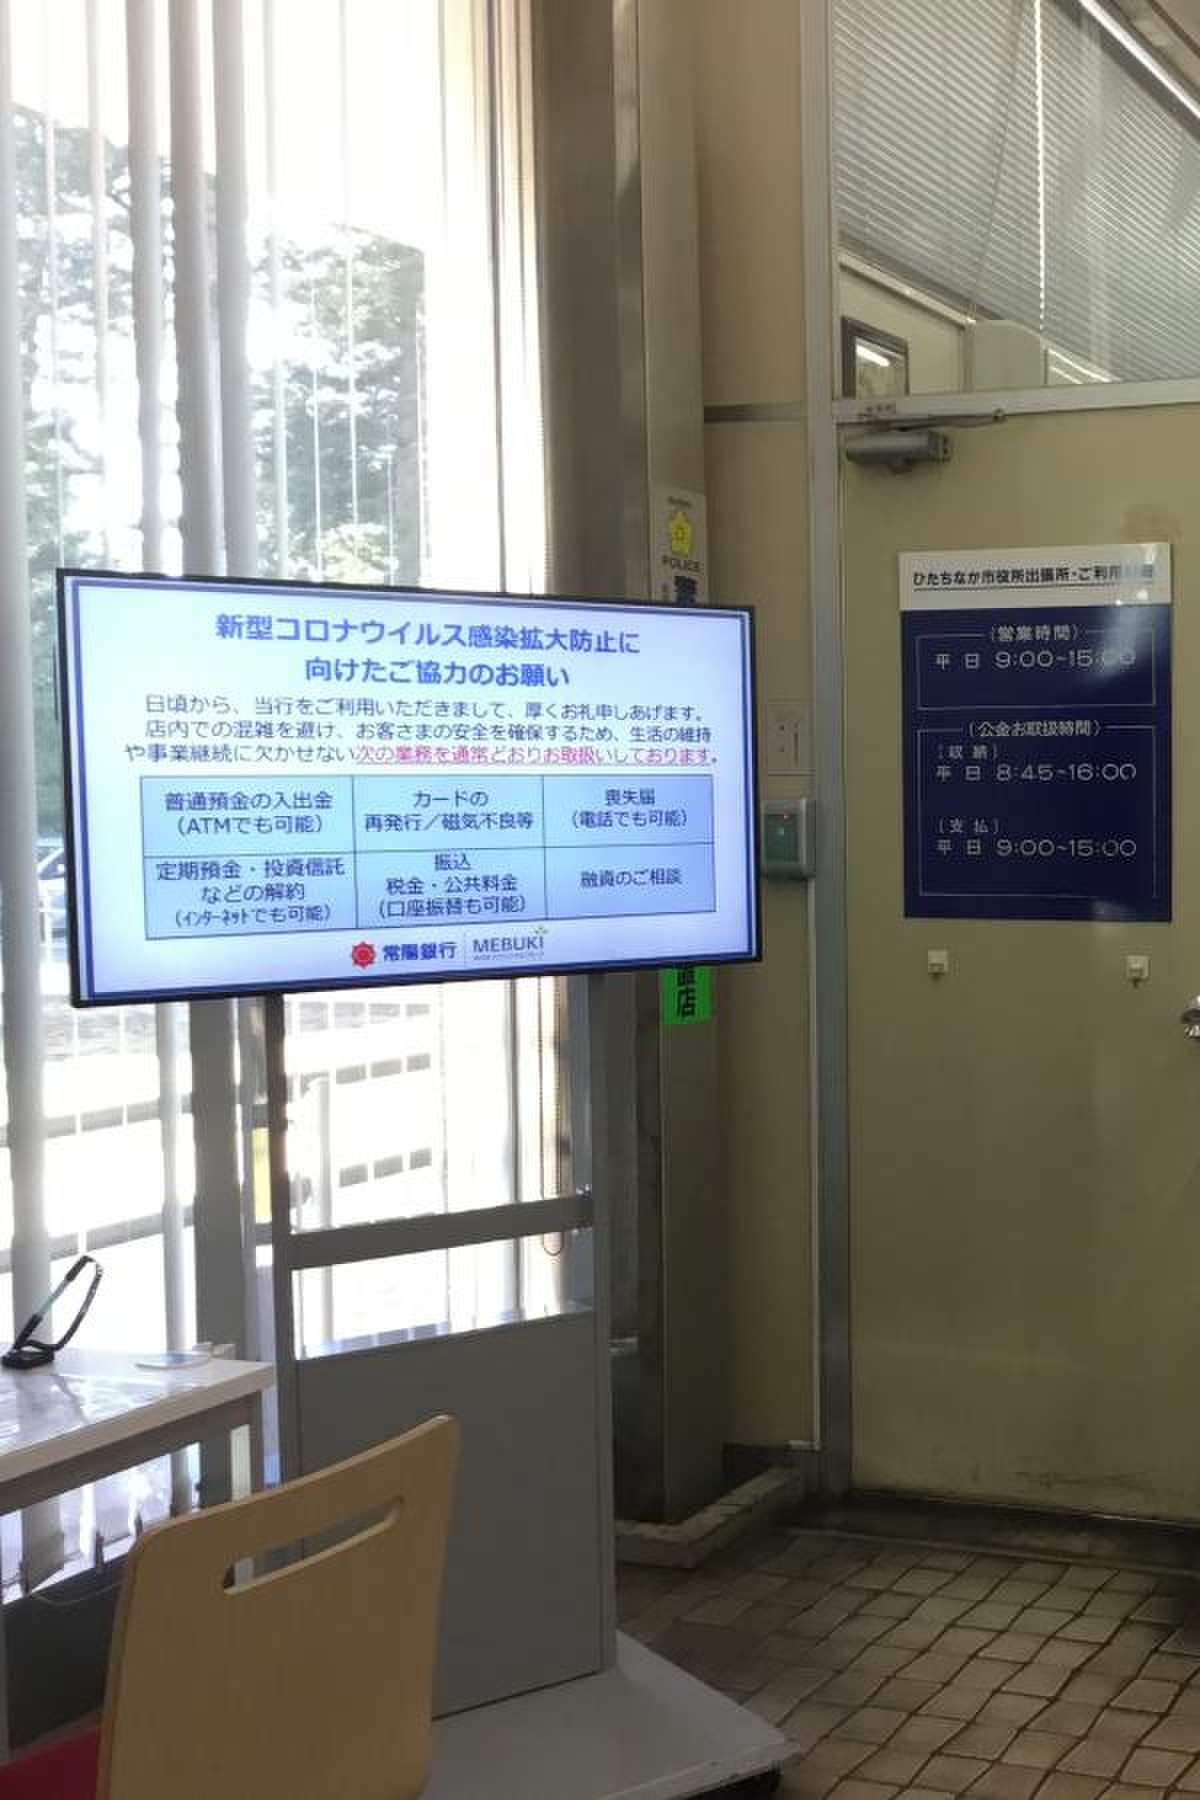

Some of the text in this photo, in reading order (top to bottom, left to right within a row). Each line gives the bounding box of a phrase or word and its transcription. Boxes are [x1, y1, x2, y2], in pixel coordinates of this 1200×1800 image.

[215, 613, 641, 653] 新型コロナウイルス感染拡大防止に
[305, 656, 570, 687] 向けたご協力のお願い
[164, 790, 333, 812] 普通預金の入出金
[412, 789, 489, 809] カードの
[156, 857, 346, 881] 定期預金・投資信託
[434, 853, 472, 872] 振込
[386, 873, 518, 896] 税金・公共料金
[580, 868, 683, 888] 融資のご相談
[201, 881, 306, 904] などの解約
[383, 942, 458, 962] 常陽銀行
[473, 935, 545, 954] MEBUKI
